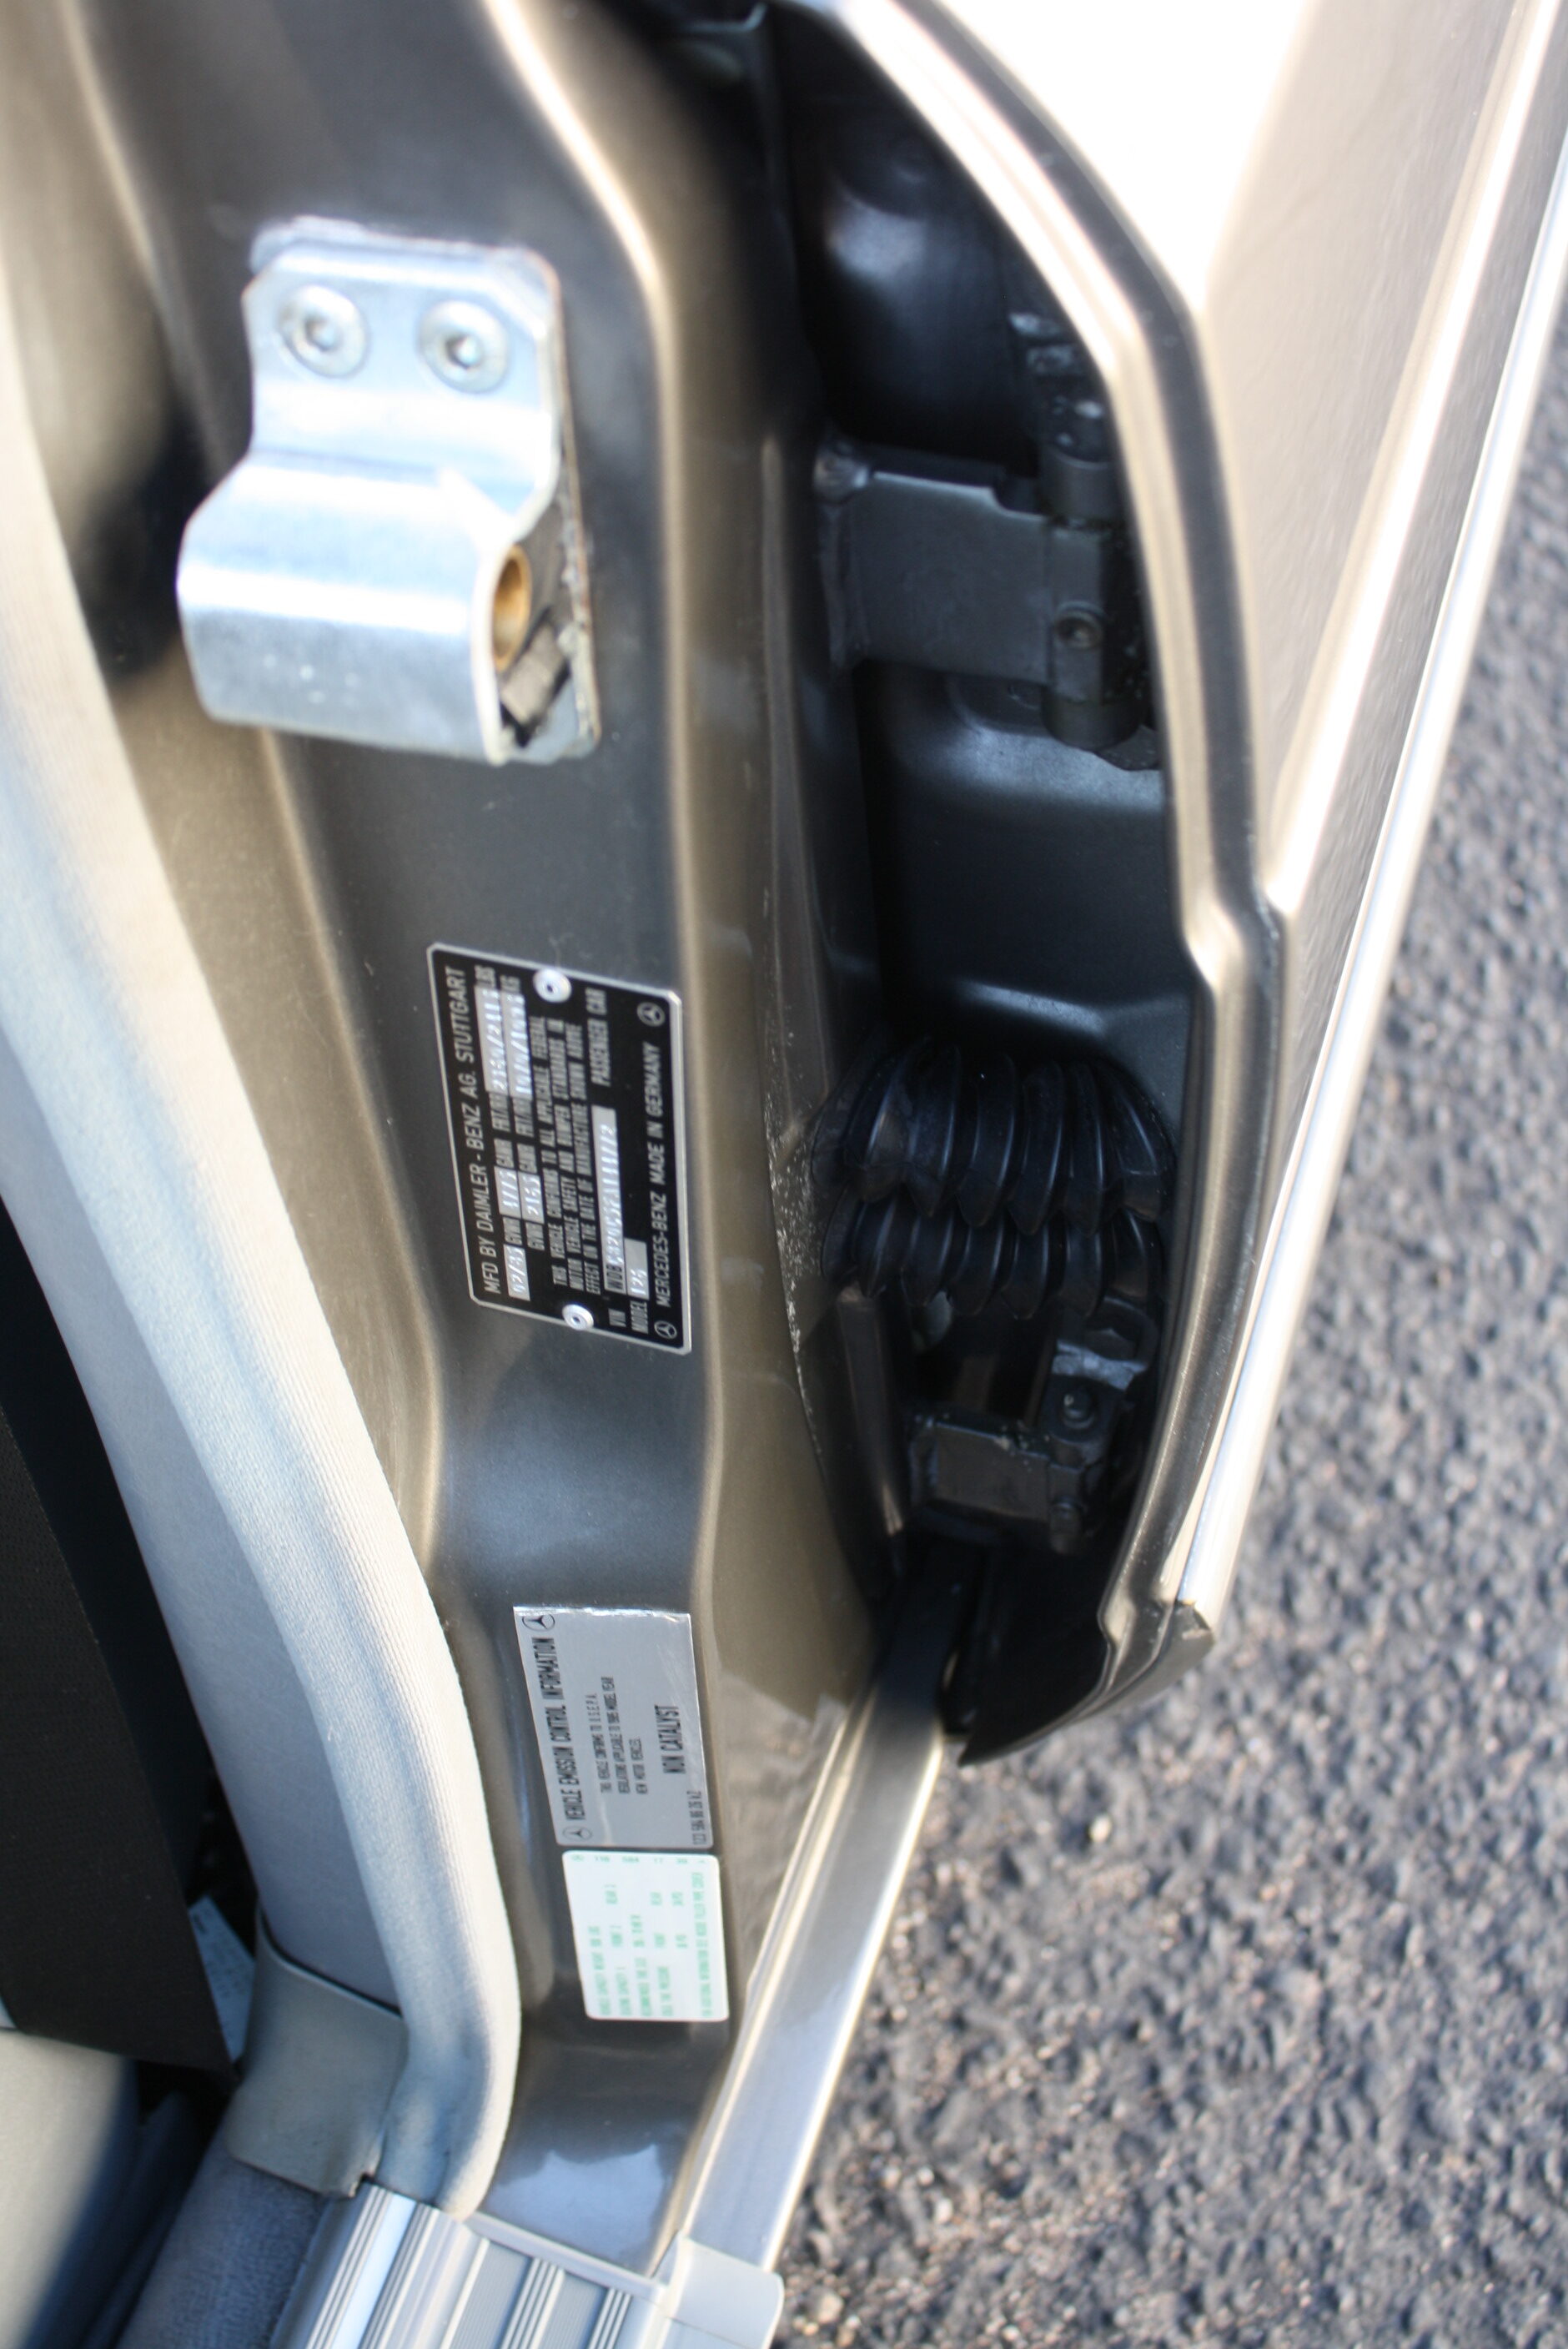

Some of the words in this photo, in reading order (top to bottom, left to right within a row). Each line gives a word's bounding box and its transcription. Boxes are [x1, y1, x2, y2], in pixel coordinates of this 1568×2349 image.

[445, 965, 475, 1064] STUTTGART
[585, 987, 606, 1015] CAR
[528, 1014, 548, 1059] FEDERAL
[546, 1017, 564, 1033] IN
[565, 1022, 584, 1059] ABOVE
[548, 1037, 569, 1099] STANDARDS
[586, 1017, 611, 1087] PASSENGER
[533, 1064, 553, 1124] APPLICABLE
[568, 1061, 586, 1100] SHOWN
[643, 1040, 663, 1118] GERMANY
[461, 1101, 485, 1150] BENZ
[539, 1127, 555, 1147] ALL
[554, 1104, 572, 1147] BUMPER
[570, 1101, 592, 1176] MANUFACTURE
[647, 1120, 664, 1139] IN
[540, 1149, 557, 1164] TO
[557, 1149, 574, 1173] AND
[648, 1141, 666, 1186] MADE
[468, 1162, 494, 1232] DAIMLER
[542, 1167, 561, 1218] CONFORMS
[560, 1175, 577, 1212] SAFETY
[576, 1177, 593, 1193] OF
[578, 1194, 595, 1220] DATE
[477, 1235, 496, 1258] BY
[547, 1222, 565, 1260] VEHICLE
[563, 1215, 580, 1254] VEHICLE
[580, 1222, 596, 1242] THE
[650, 1190, 671, 1307] MERCEDES-BENZ
[581, 1243, 598, 1260] ON
[480, 1260, 500, 1294] MFD
[551, 1264, 567, 1286] THIS
[566, 1257, 583, 1290] MOTOR
[583, 1261, 601, 1295] EFFECT
[608, 1308, 626, 1328] VIN
[630, 1298, 648, 1334] MODEL
[531, 1637, 564, 1699] INFORMATION
[545, 1705, 572, 1742] CONTROL
[654, 1704, 683, 1751] CATALYST
[552, 1747, 579, 1784] EMISSION
[661, 1755, 685, 1773] NON
[560, 1788, 585, 1820] VEHICLE
